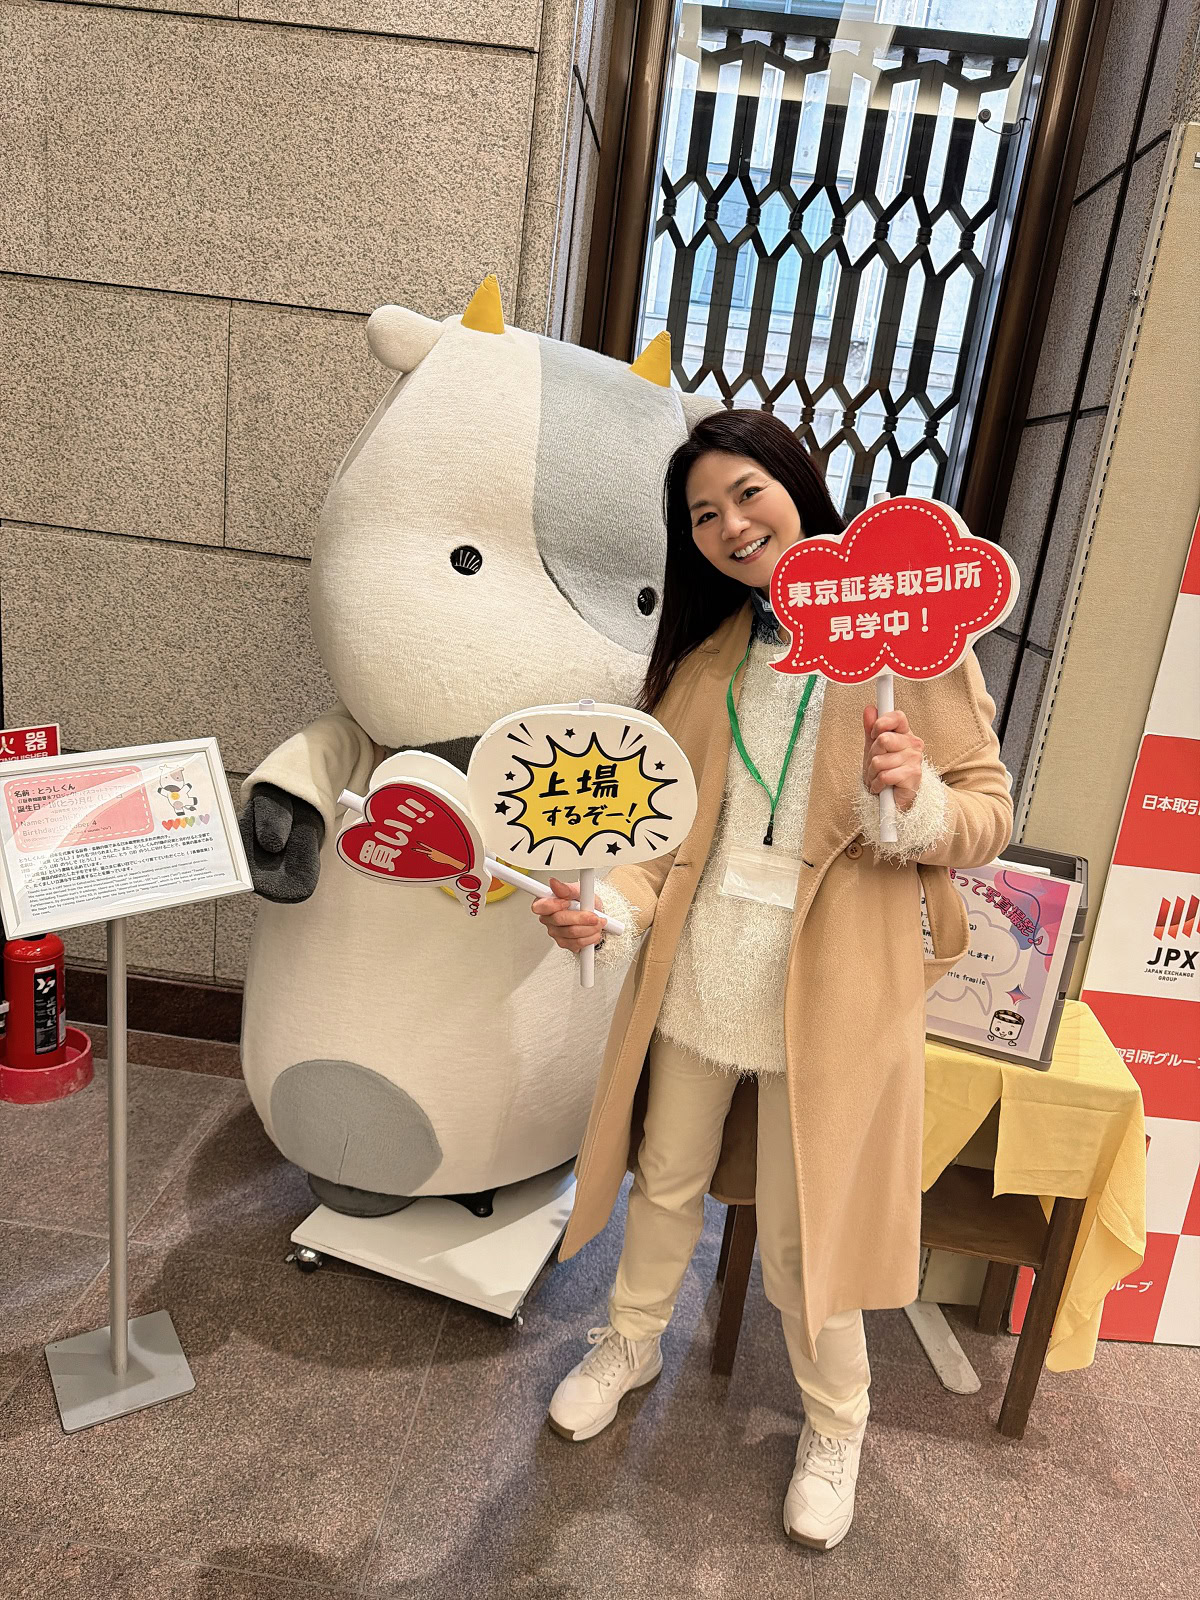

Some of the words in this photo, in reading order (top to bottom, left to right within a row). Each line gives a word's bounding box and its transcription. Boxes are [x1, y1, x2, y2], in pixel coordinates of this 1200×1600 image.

[786, 560, 982, 608] 東京証券取引所
[538, 763, 619, 799] 上場
[1146, 946, 1199, 970] JPX
[963, 974, 986, 986] fragile
[1164, 970, 1194, 978] EXCHANGE
[1115, 1047, 1200, 1070] 引所グルー
